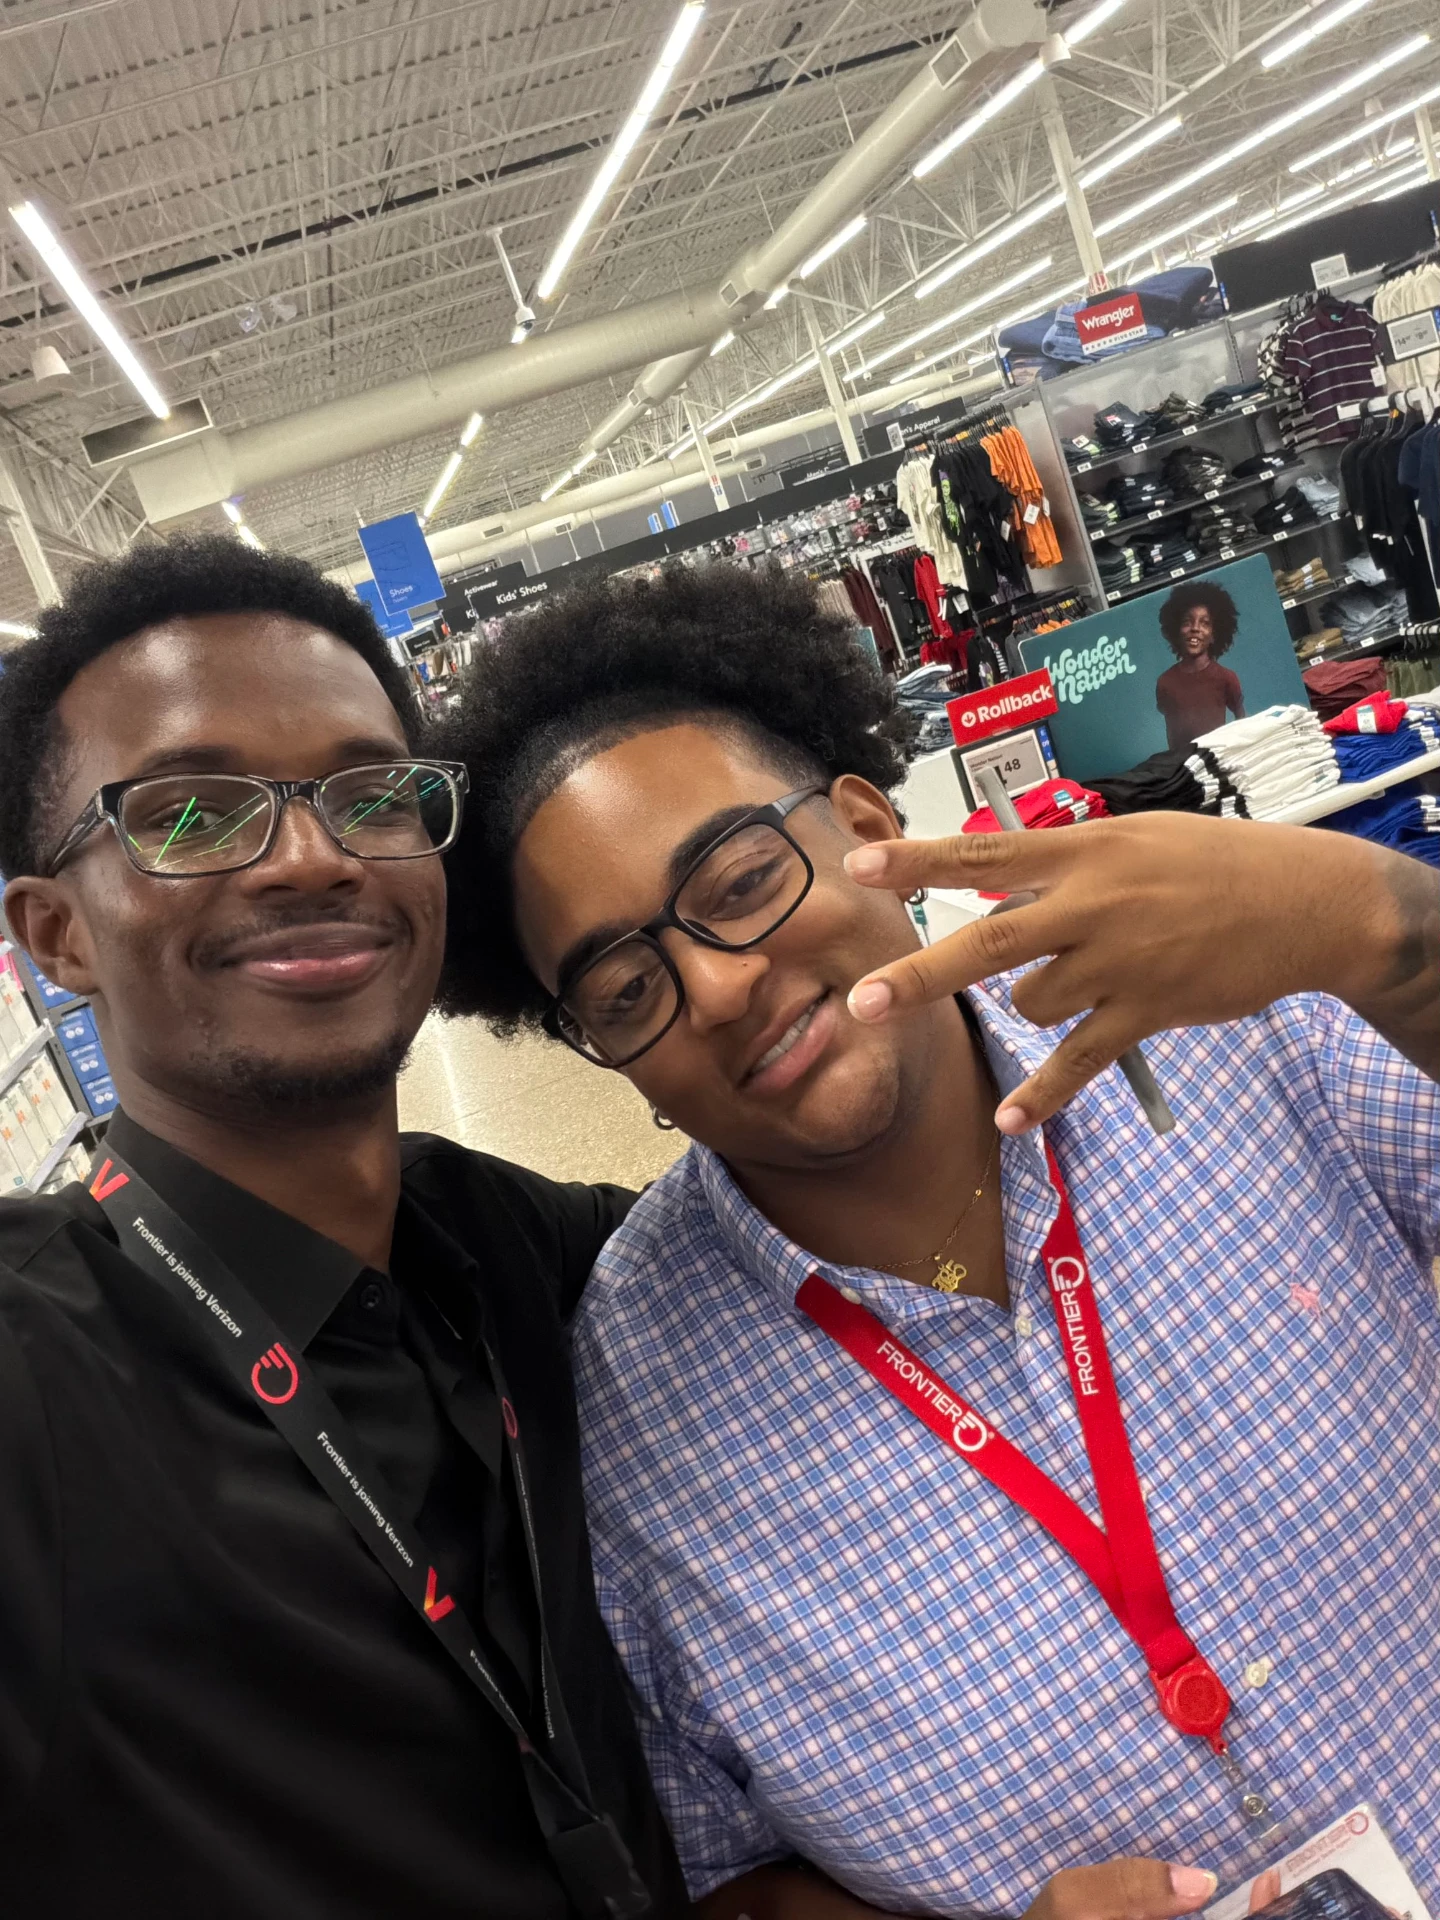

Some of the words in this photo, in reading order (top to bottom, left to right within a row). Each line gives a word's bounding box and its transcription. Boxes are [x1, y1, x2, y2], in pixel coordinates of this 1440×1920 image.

[1082, 305, 1134, 331] Wrangler
[914, 415, 941, 431] Apparel
[389, 585, 414, 598] Shoes
[464, 580, 498, 596] Activewear
[496, 589, 517, 604] Kids'
[519, 582, 548, 597] Shoes
[1044, 636, 1127, 686] Wonder
[977, 685, 1053, 723] Rollback
[132, 1217, 169, 1257] Frontier
[165, 1252, 177, 1267] is
[171, 1261, 208, 1300] joining
[206, 1294, 242, 1337] Verizon
[1061, 1291, 1099, 1396] FRONTIER
[876, 1341, 963, 1422] FRONTIER
[317, 1431, 352, 1478] Frontier
[349, 1475, 360, 1490] is
[355, 1486, 386, 1527] joining
[384, 1522, 414, 1568] Verizon
